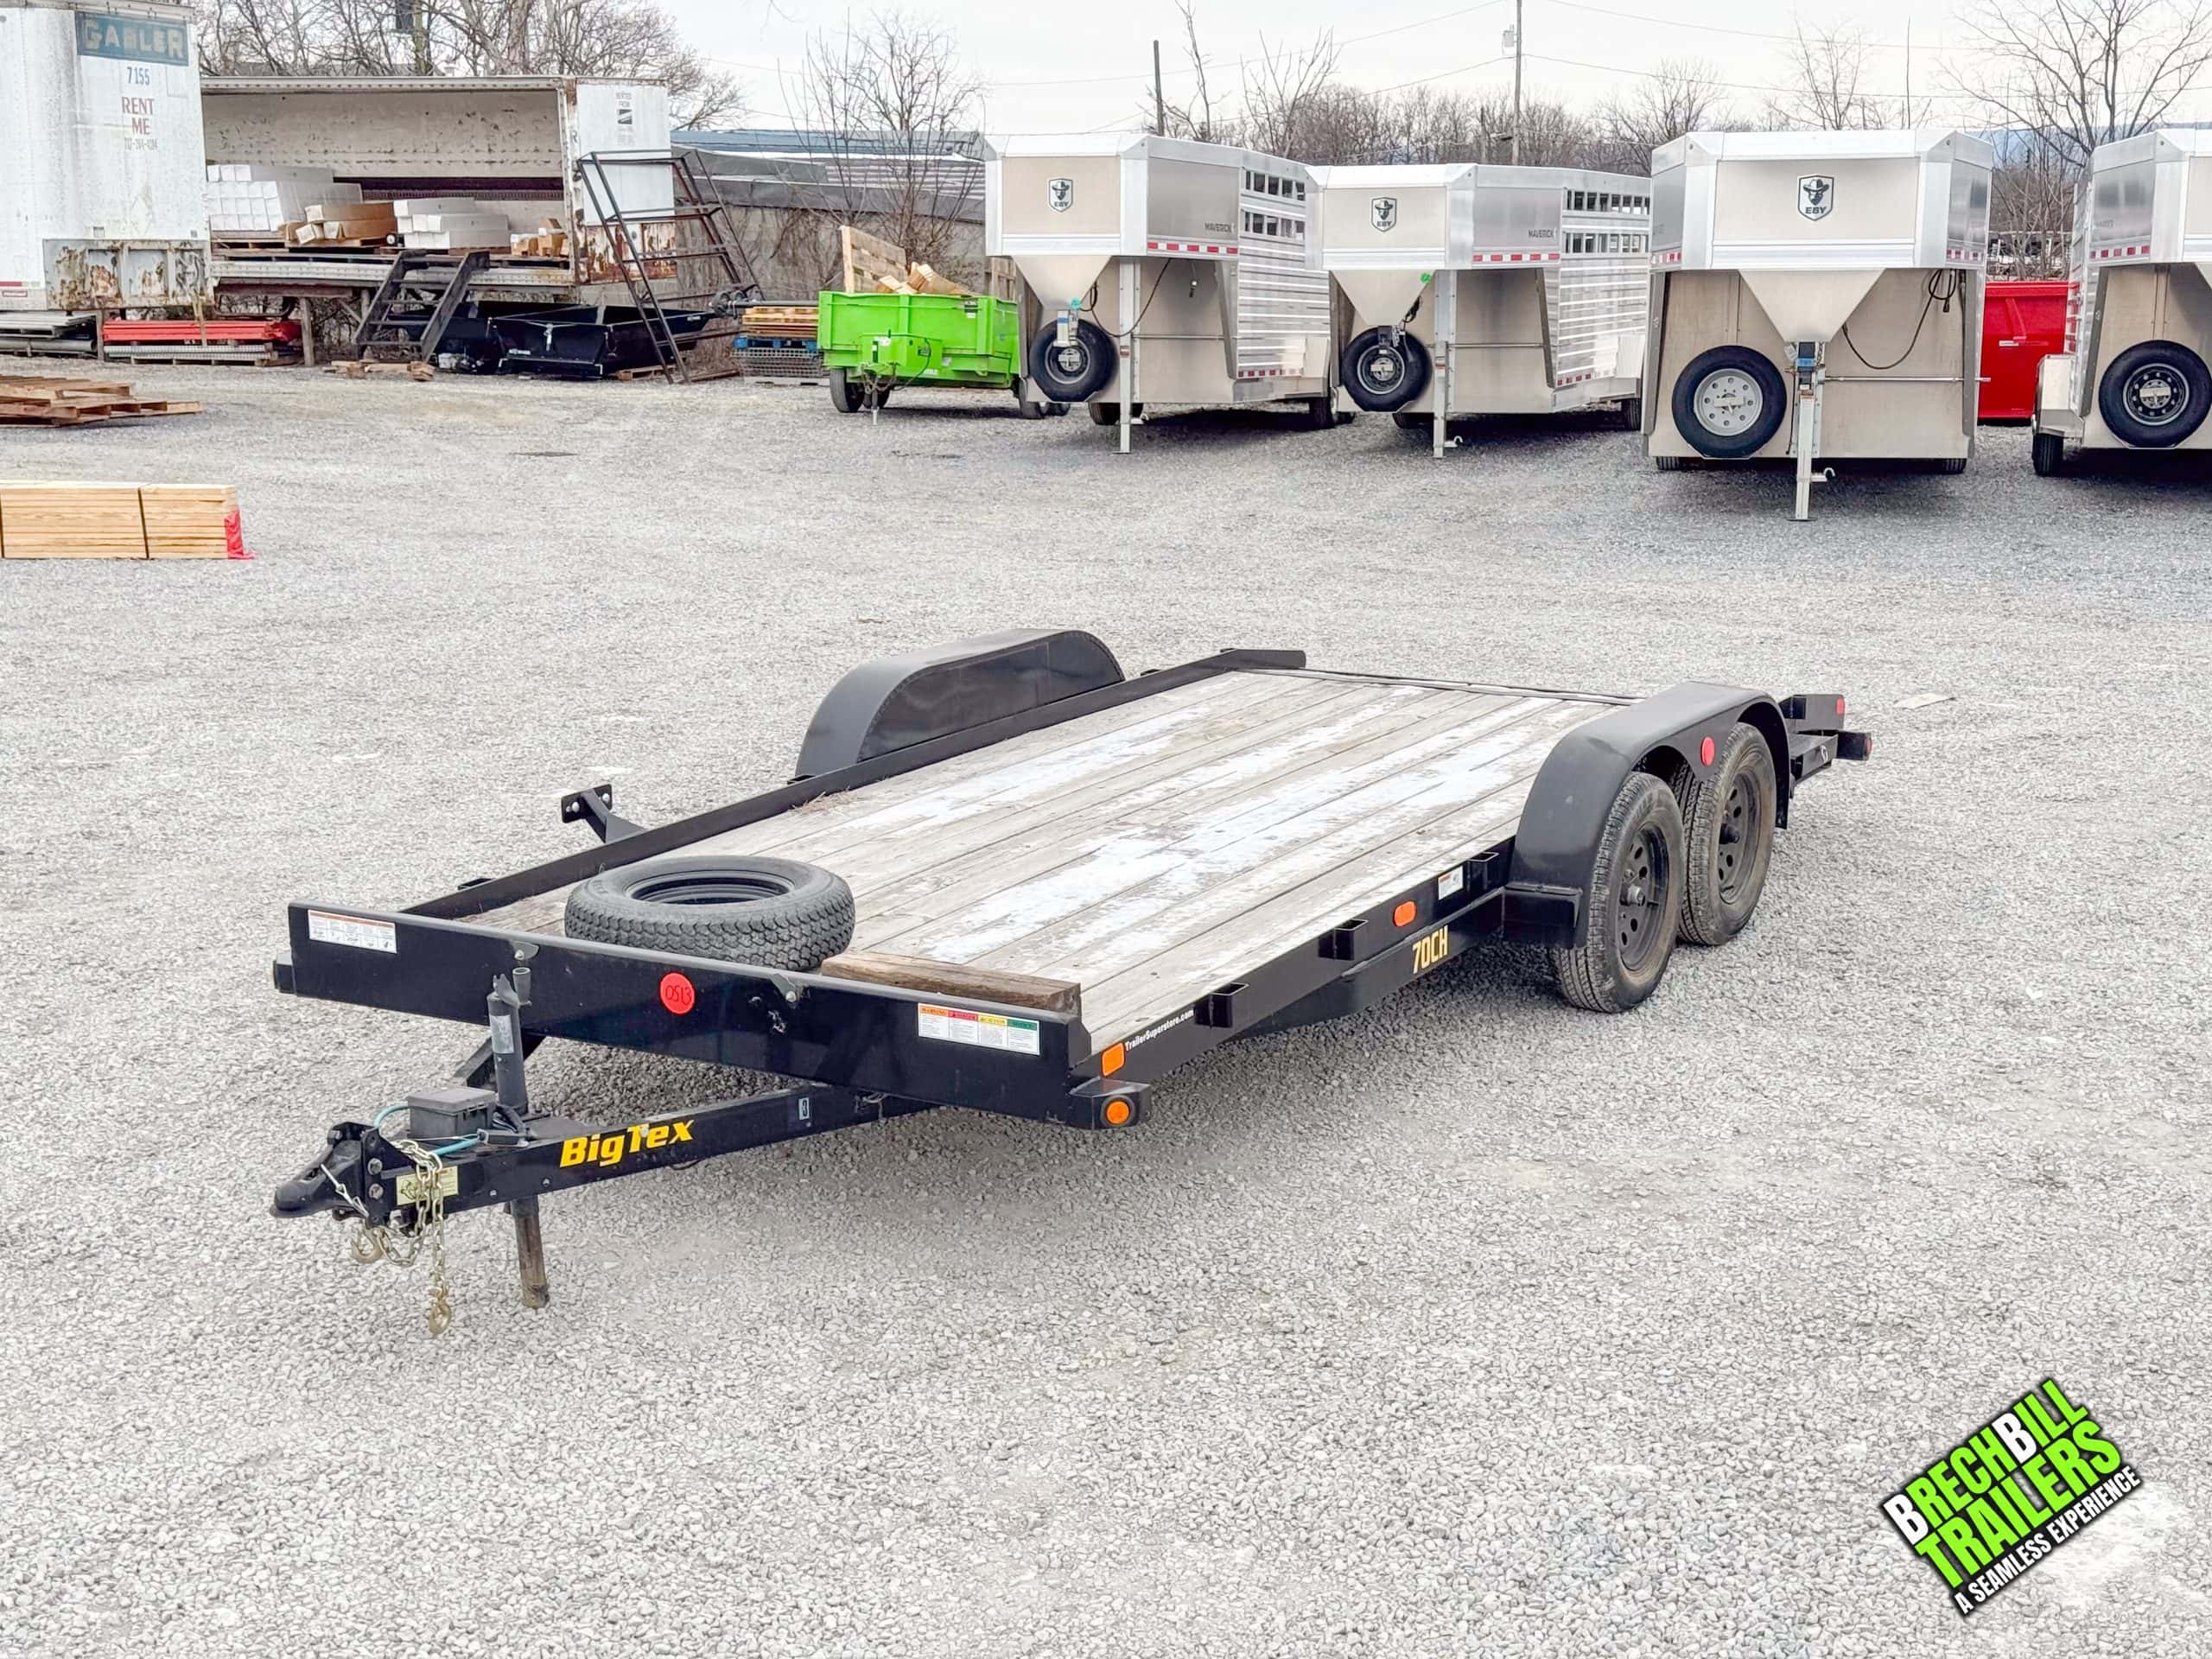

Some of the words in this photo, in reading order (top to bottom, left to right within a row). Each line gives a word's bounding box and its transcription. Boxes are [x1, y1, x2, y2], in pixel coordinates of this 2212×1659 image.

[126, 67, 151, 86] 7155
[121, 96, 155, 115] RENT
[131, 117, 151, 136] ME
